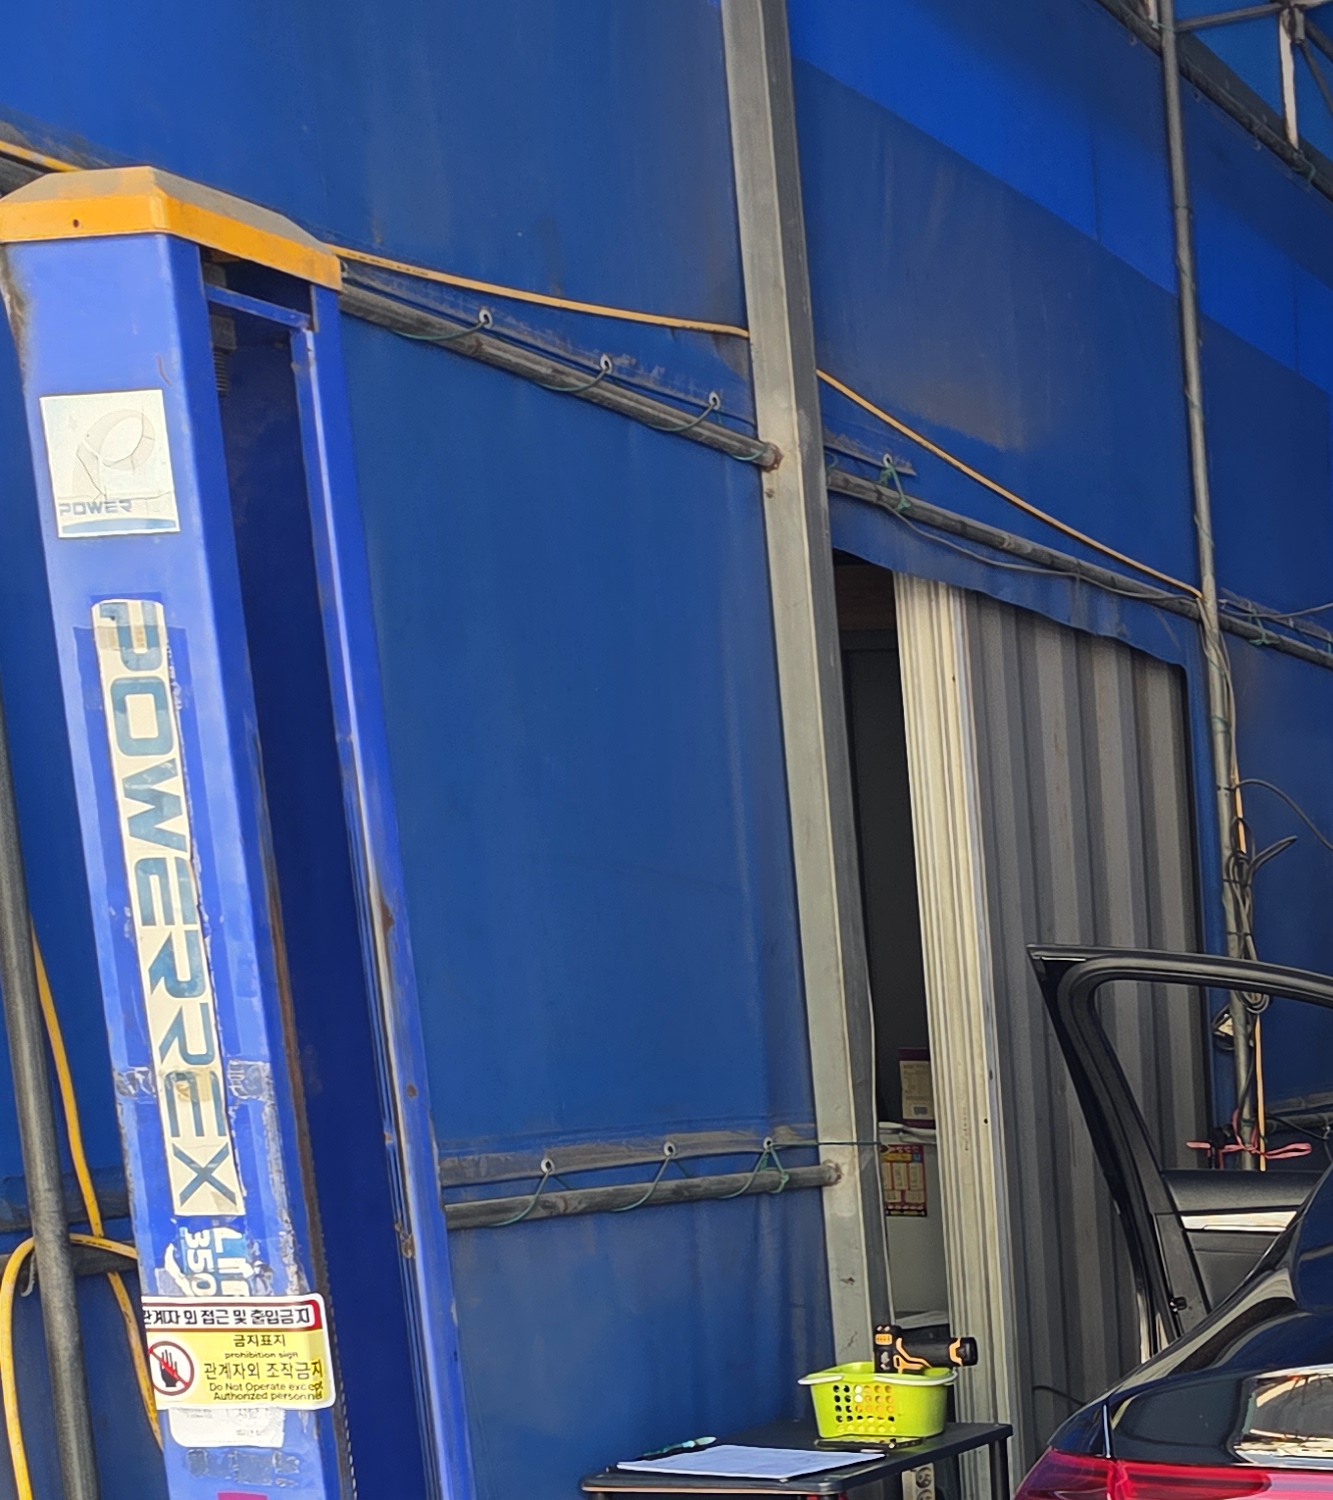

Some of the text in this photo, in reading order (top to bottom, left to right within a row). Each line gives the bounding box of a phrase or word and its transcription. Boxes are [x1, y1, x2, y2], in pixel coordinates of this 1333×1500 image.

[58, 499, 133, 517] POWER
[184, 1230, 217, 1297] 350
[201, 1309, 229, 1325] 접근
[233, 1309, 247, 1325] 및
[250, 1307, 311, 1325] 출입금지
[233, 1334, 286, 1348] 금지표지
[203, 1359, 324, 1381] 관계자외 조작금지
[209, 1382, 223, 1392] Do
[225, 1382, 243, 1391] Not
[245, 1382, 287, 1393] Operate
